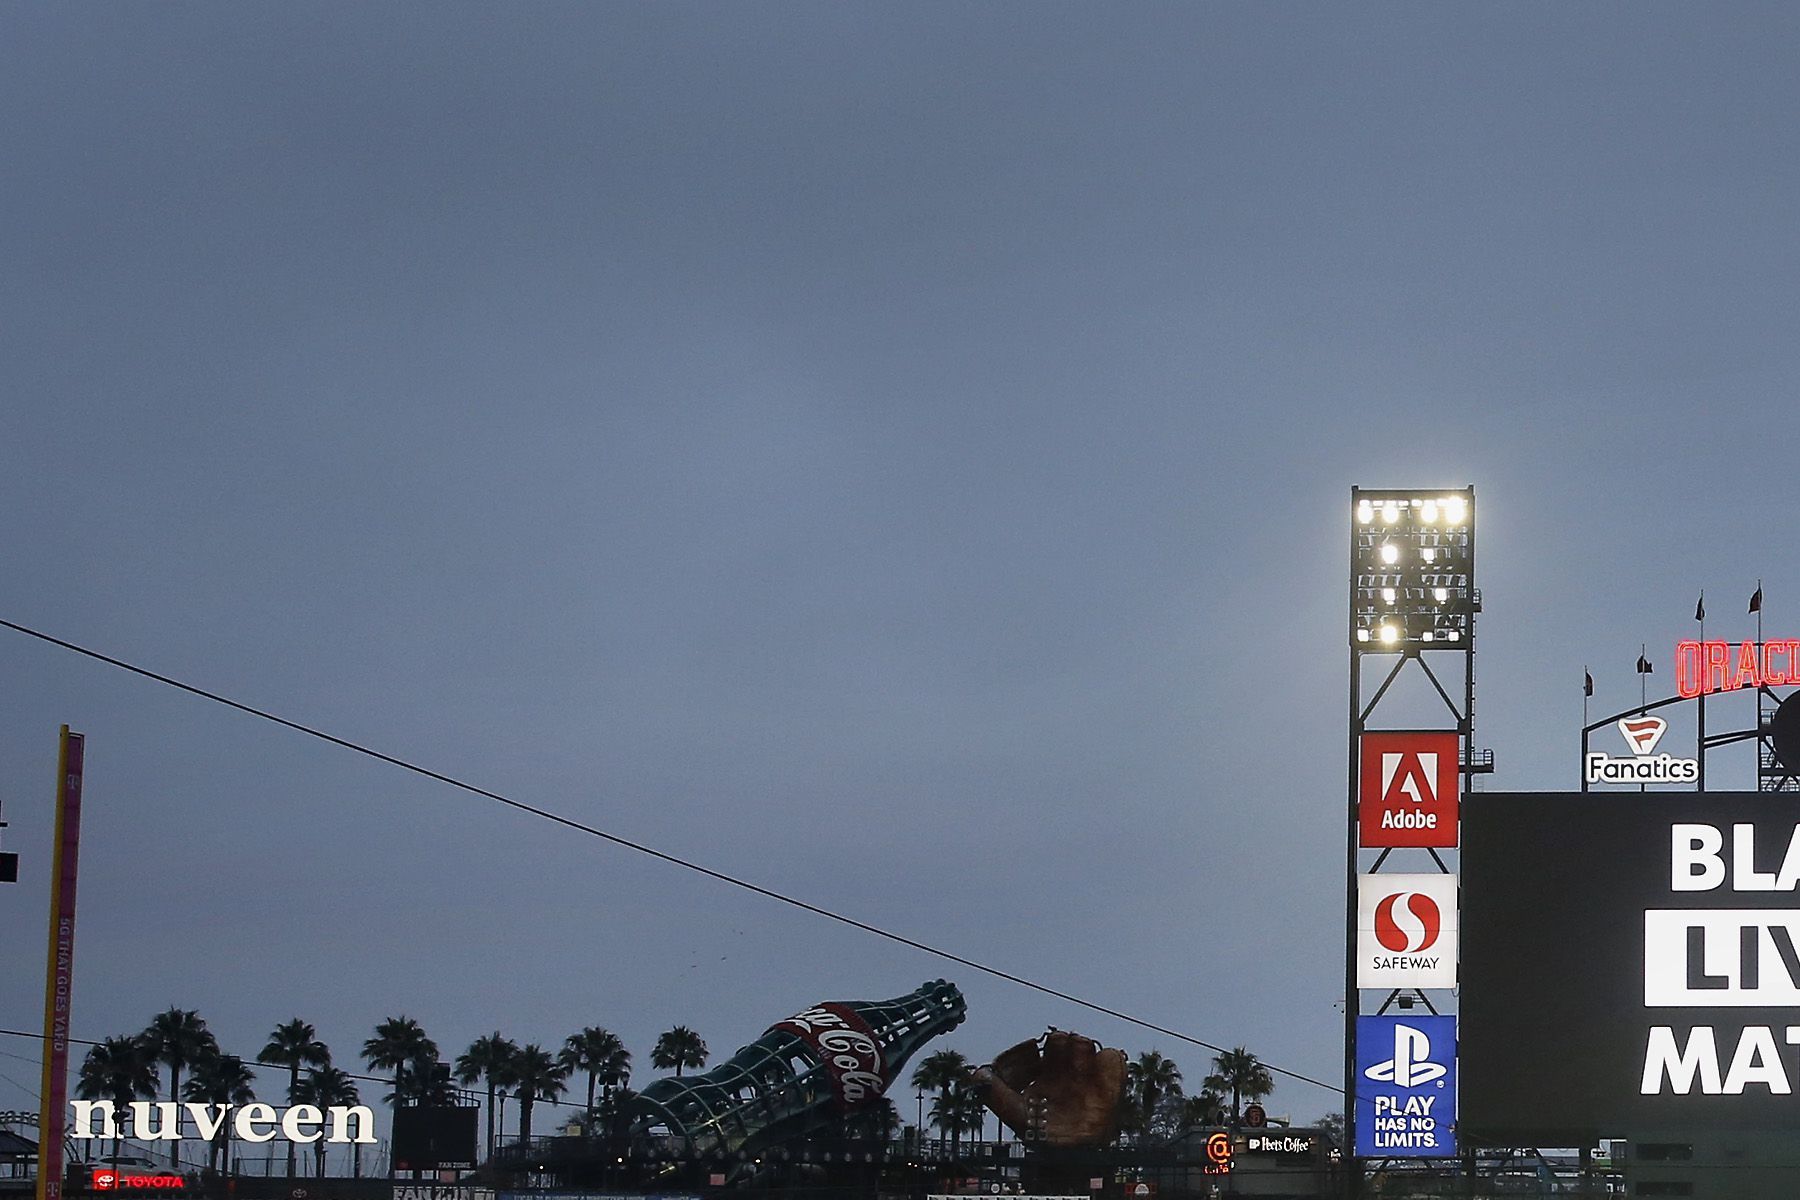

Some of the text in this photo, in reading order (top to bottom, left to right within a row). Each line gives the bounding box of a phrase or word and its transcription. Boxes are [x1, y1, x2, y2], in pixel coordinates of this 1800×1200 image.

[1591, 757, 1695, 780] Fanatics
[1381, 809, 1437, 829] Adobe
[1373, 956, 1439, 970] SAFEWAY
[54, 979, 70, 1012] GOES
[1375, 1096, 1435, 1116] PLAY
[69, 1099, 378, 1144] nuveen
[1375, 1117, 1435, 1131] HAS NO
[1283, 1136, 1309, 1153] Coffee
[1375, 1132, 1439, 1148] LIMITS.
[124, 1175, 185, 1188] TOYOTA
[393, 1186, 432, 1200] FAN
